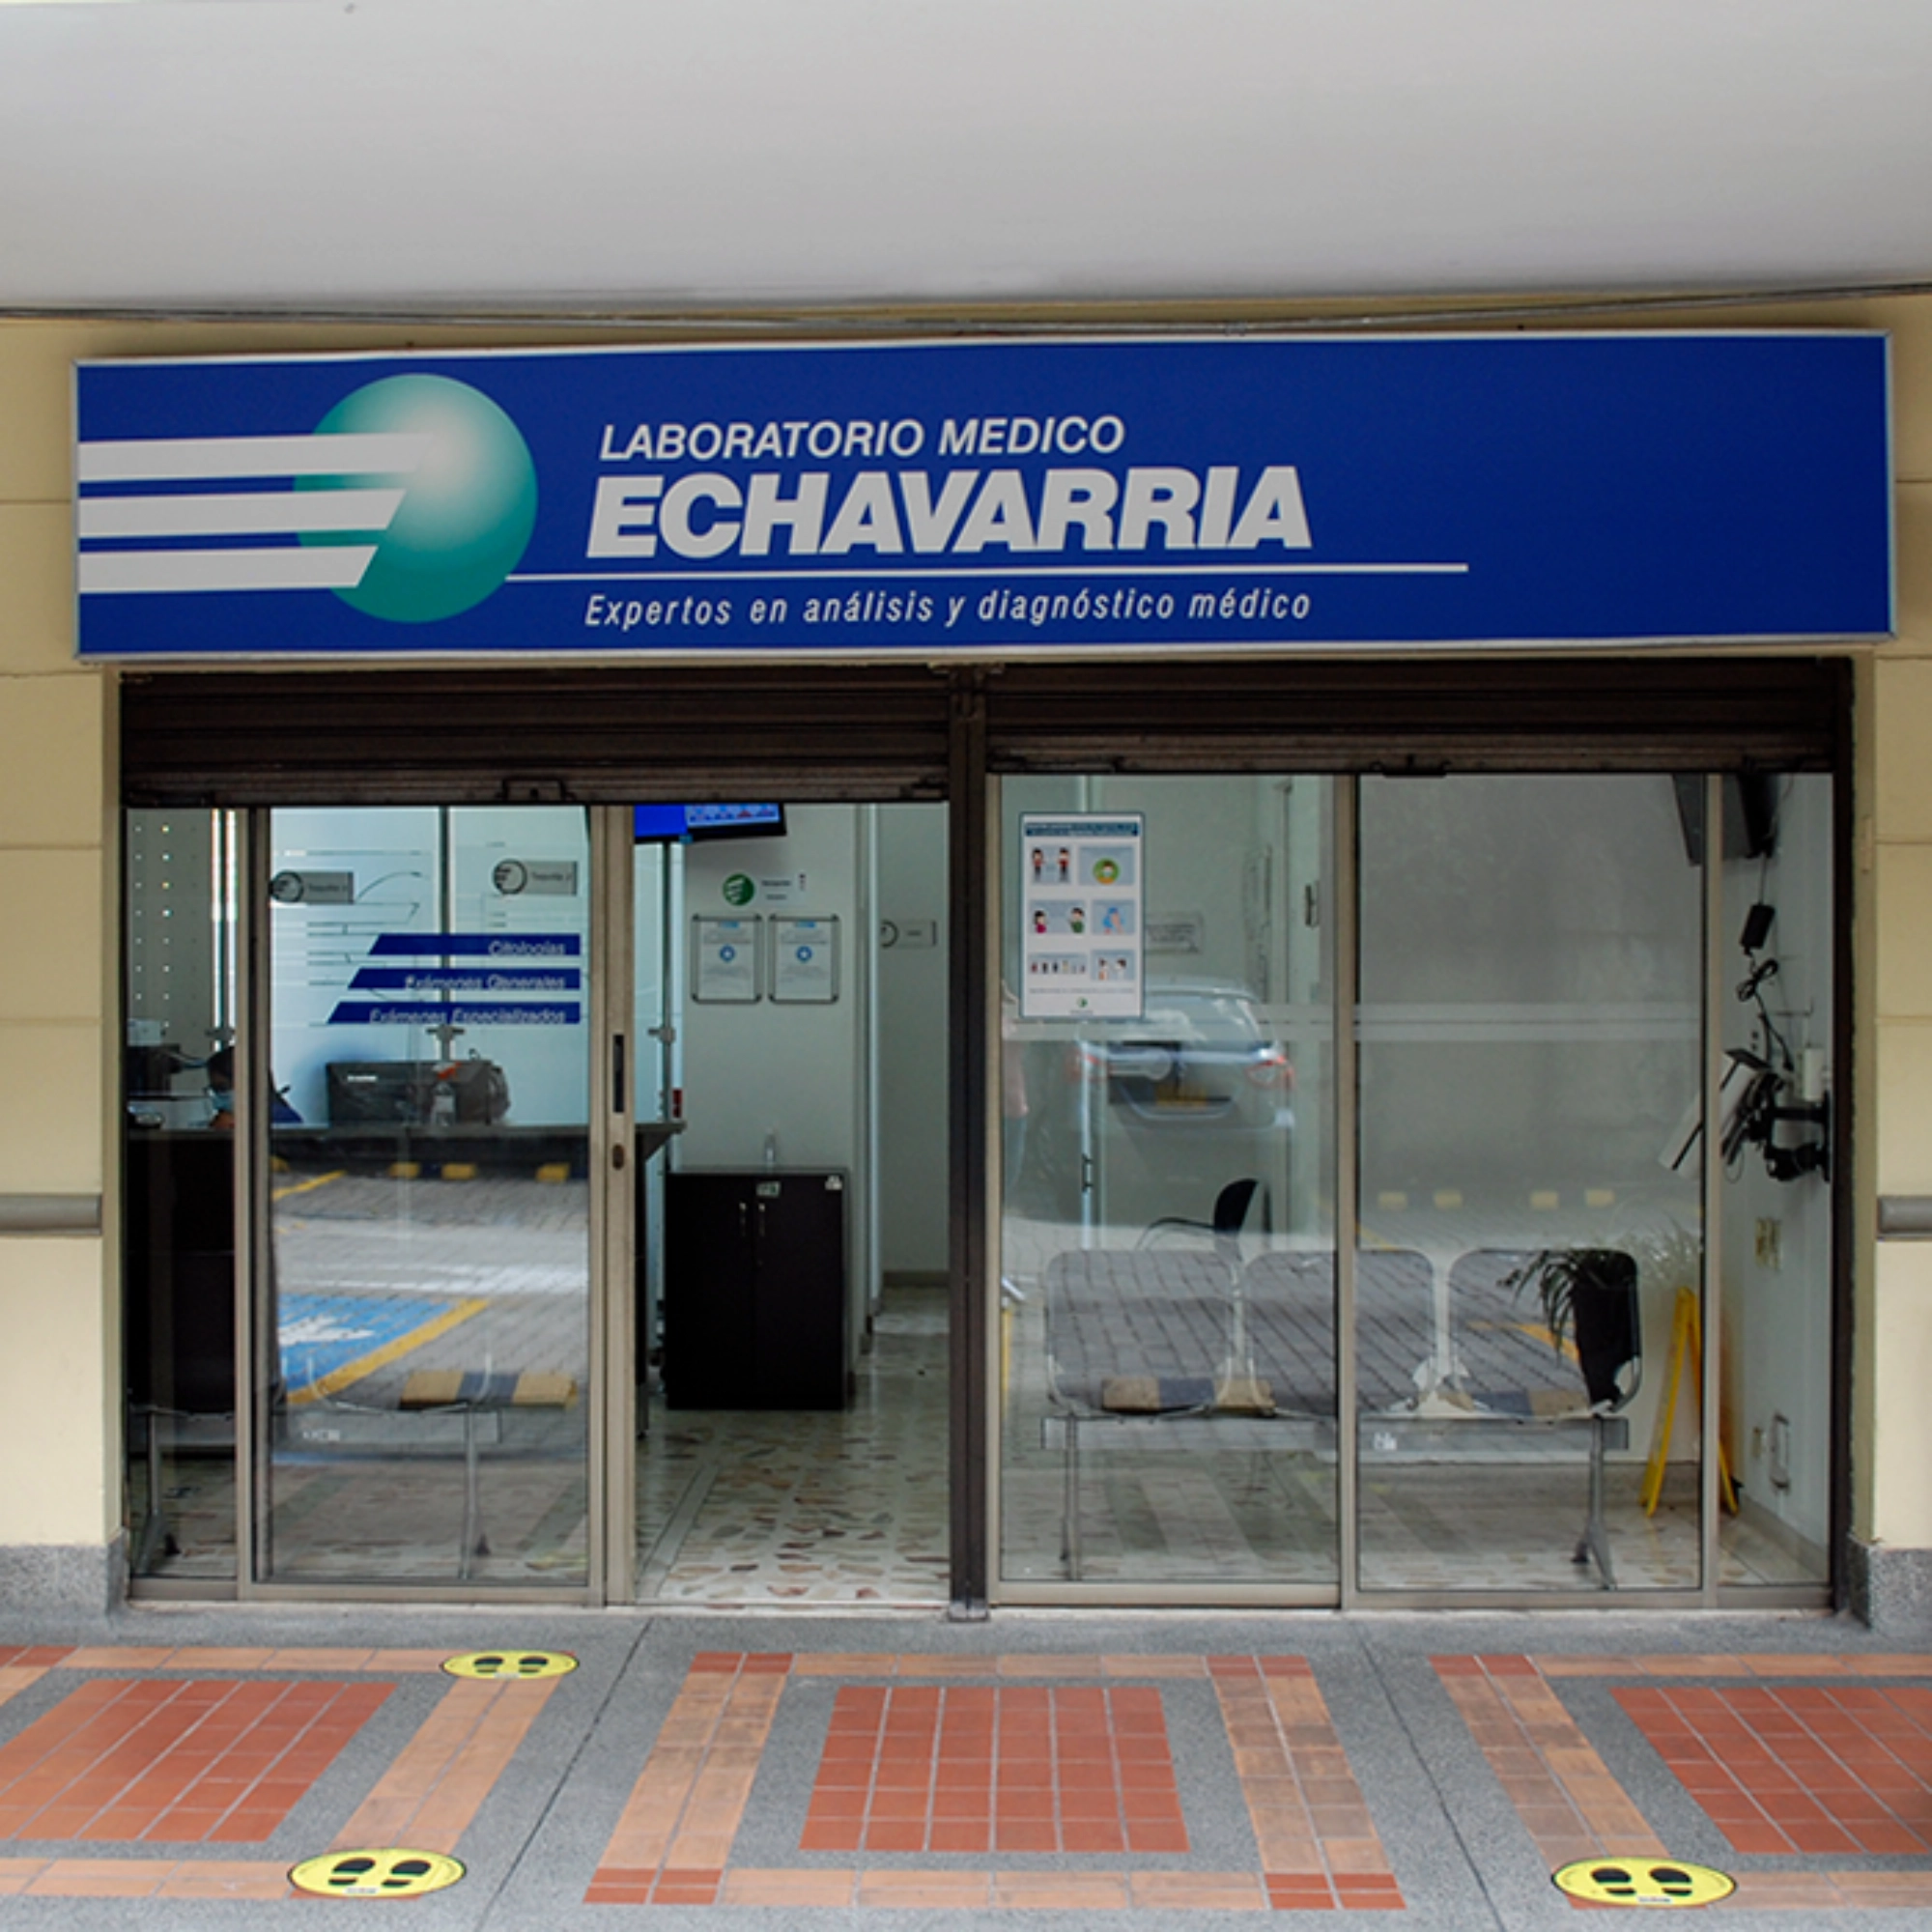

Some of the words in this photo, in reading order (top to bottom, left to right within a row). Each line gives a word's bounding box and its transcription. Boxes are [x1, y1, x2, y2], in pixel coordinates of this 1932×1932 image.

[600, 419, 923, 460] LABORATORIO
[939, 415, 1123, 454] MEDICO
[587, 467, 1311, 557] ECHAVARRIA
[585, 595, 730, 630] Expertos
[751, 600, 786, 623] en
[804, 591, 932, 621] análisis
[947, 598, 964, 627] y
[980, 588, 1173, 625] diagnóstico
[1189, 588, 1309, 618] médico
